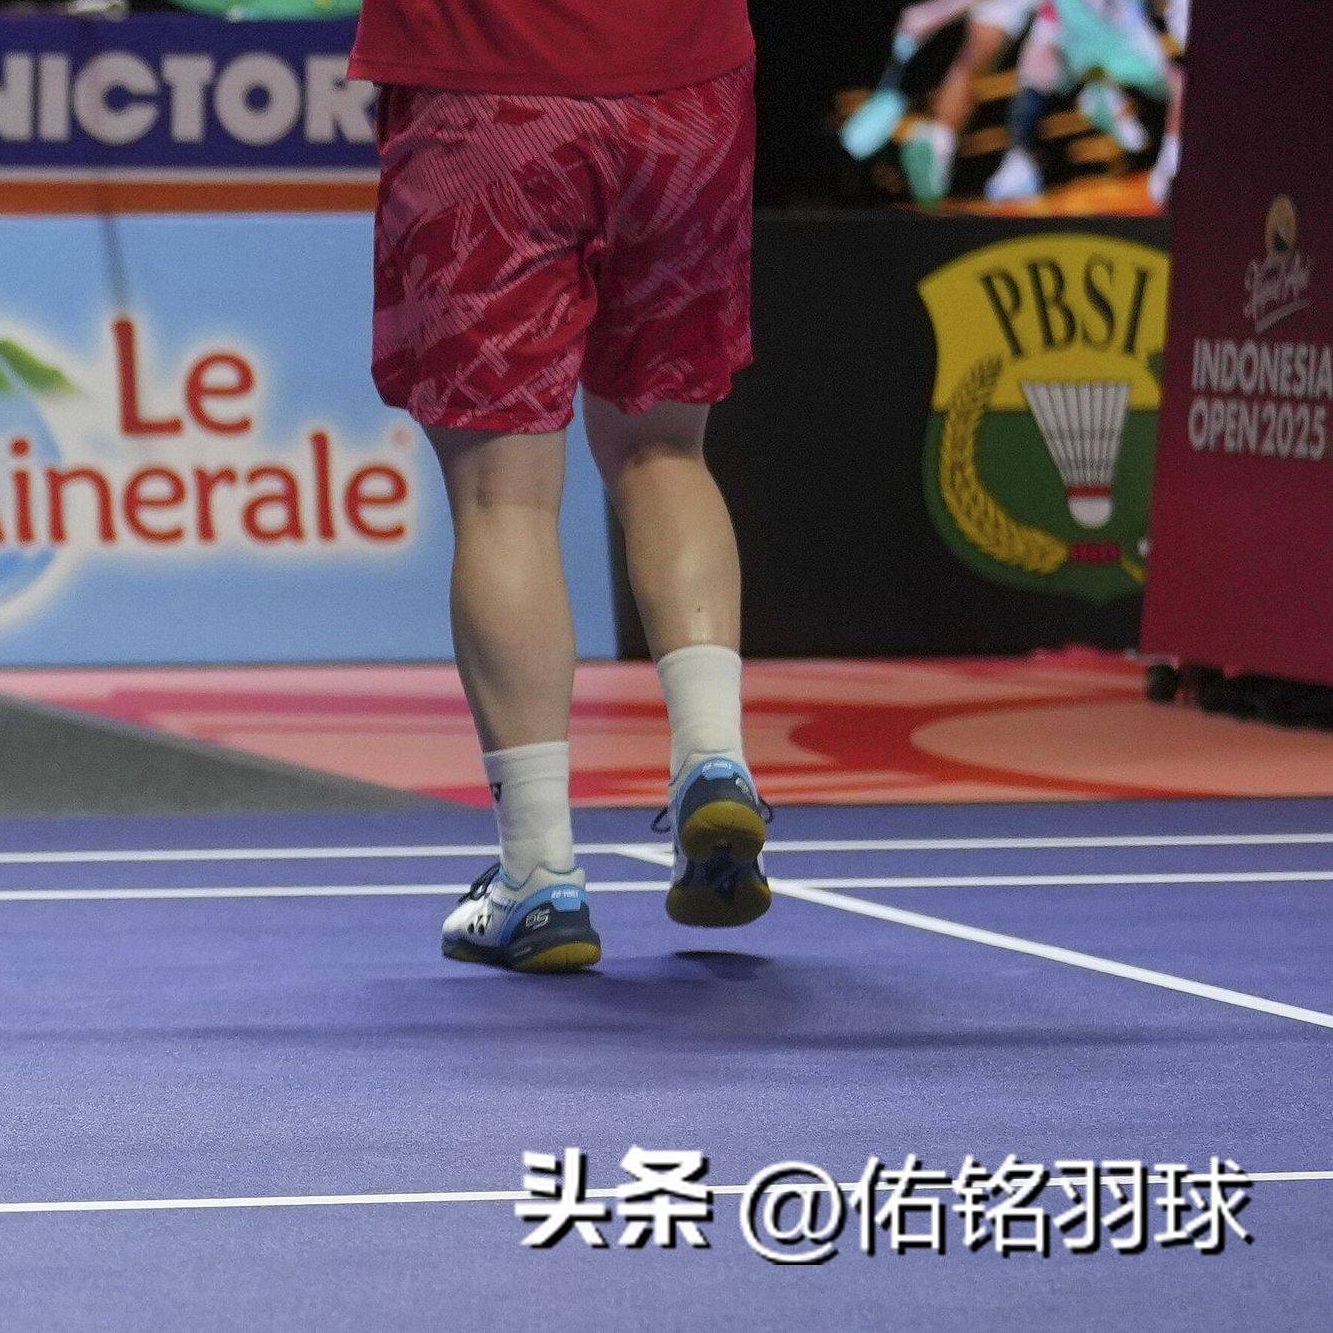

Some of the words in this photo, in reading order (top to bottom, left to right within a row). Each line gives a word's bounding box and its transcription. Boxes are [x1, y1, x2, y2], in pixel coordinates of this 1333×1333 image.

[979, 256, 1152, 358] PBSI
[111, 318, 256, 436] Le
[1191, 338, 1333, 399] INDONESIA
[1187, 396, 1261, 452] OPEN
